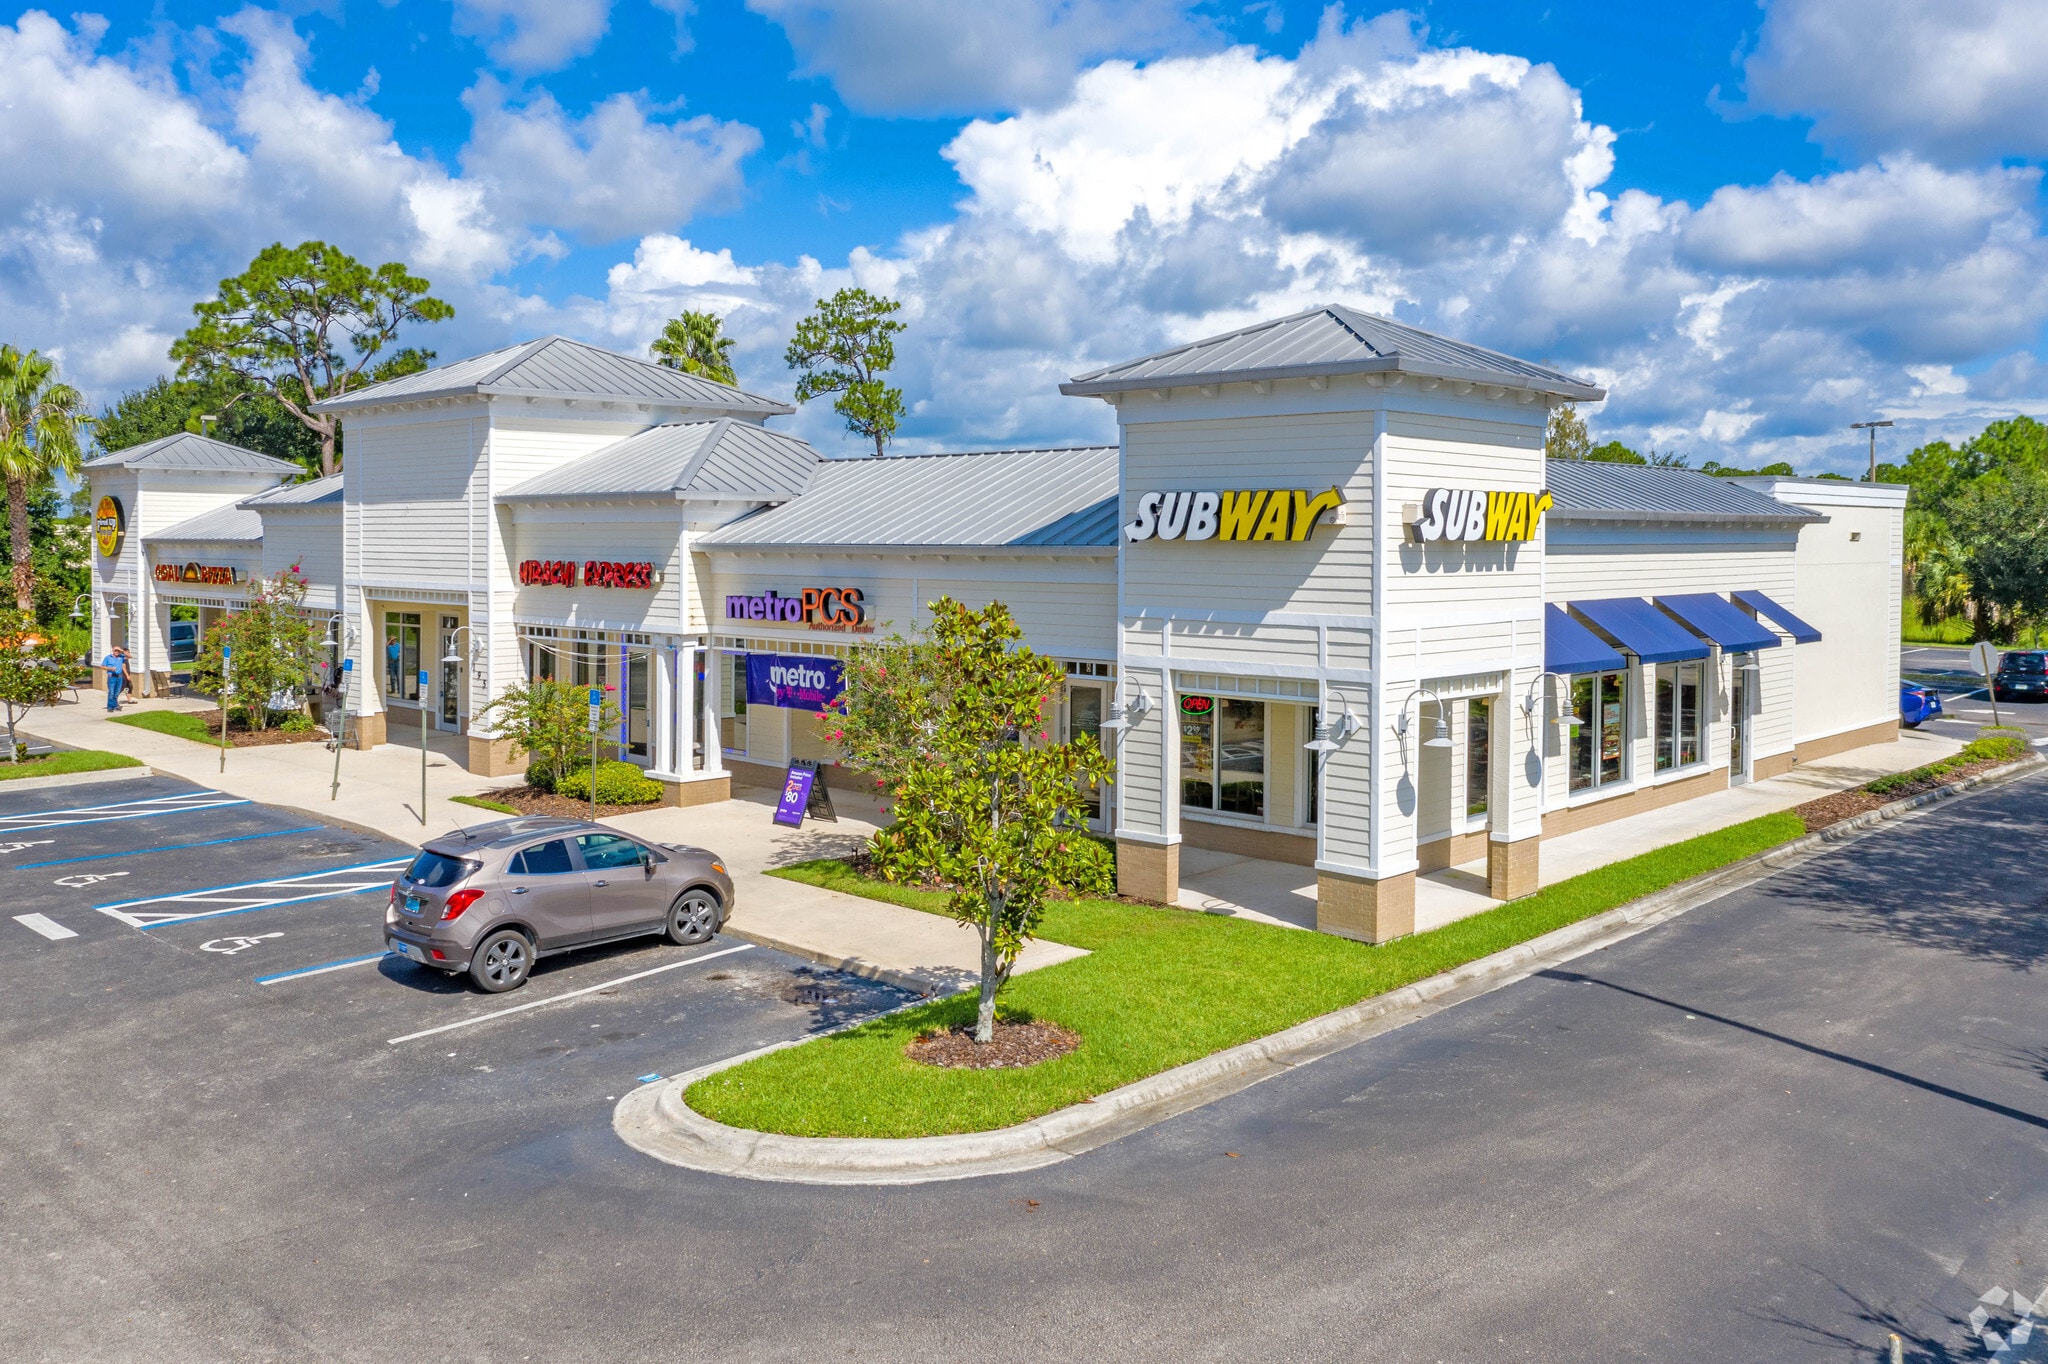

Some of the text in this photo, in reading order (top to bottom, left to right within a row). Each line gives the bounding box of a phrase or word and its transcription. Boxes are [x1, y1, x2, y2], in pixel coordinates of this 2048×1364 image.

[1124, 485, 1345, 542] SUBWAY
[1420, 488, 1553, 542] SUBWAY
[155, 563, 236, 585] COAL PIZZA
[519, 560, 655, 589] HIBACHI EXPRESS
[808, 621, 876, 634] Authorized Dealer
[769, 664, 826, 690] metro
[1183, 697, 1211, 710] OPEN
